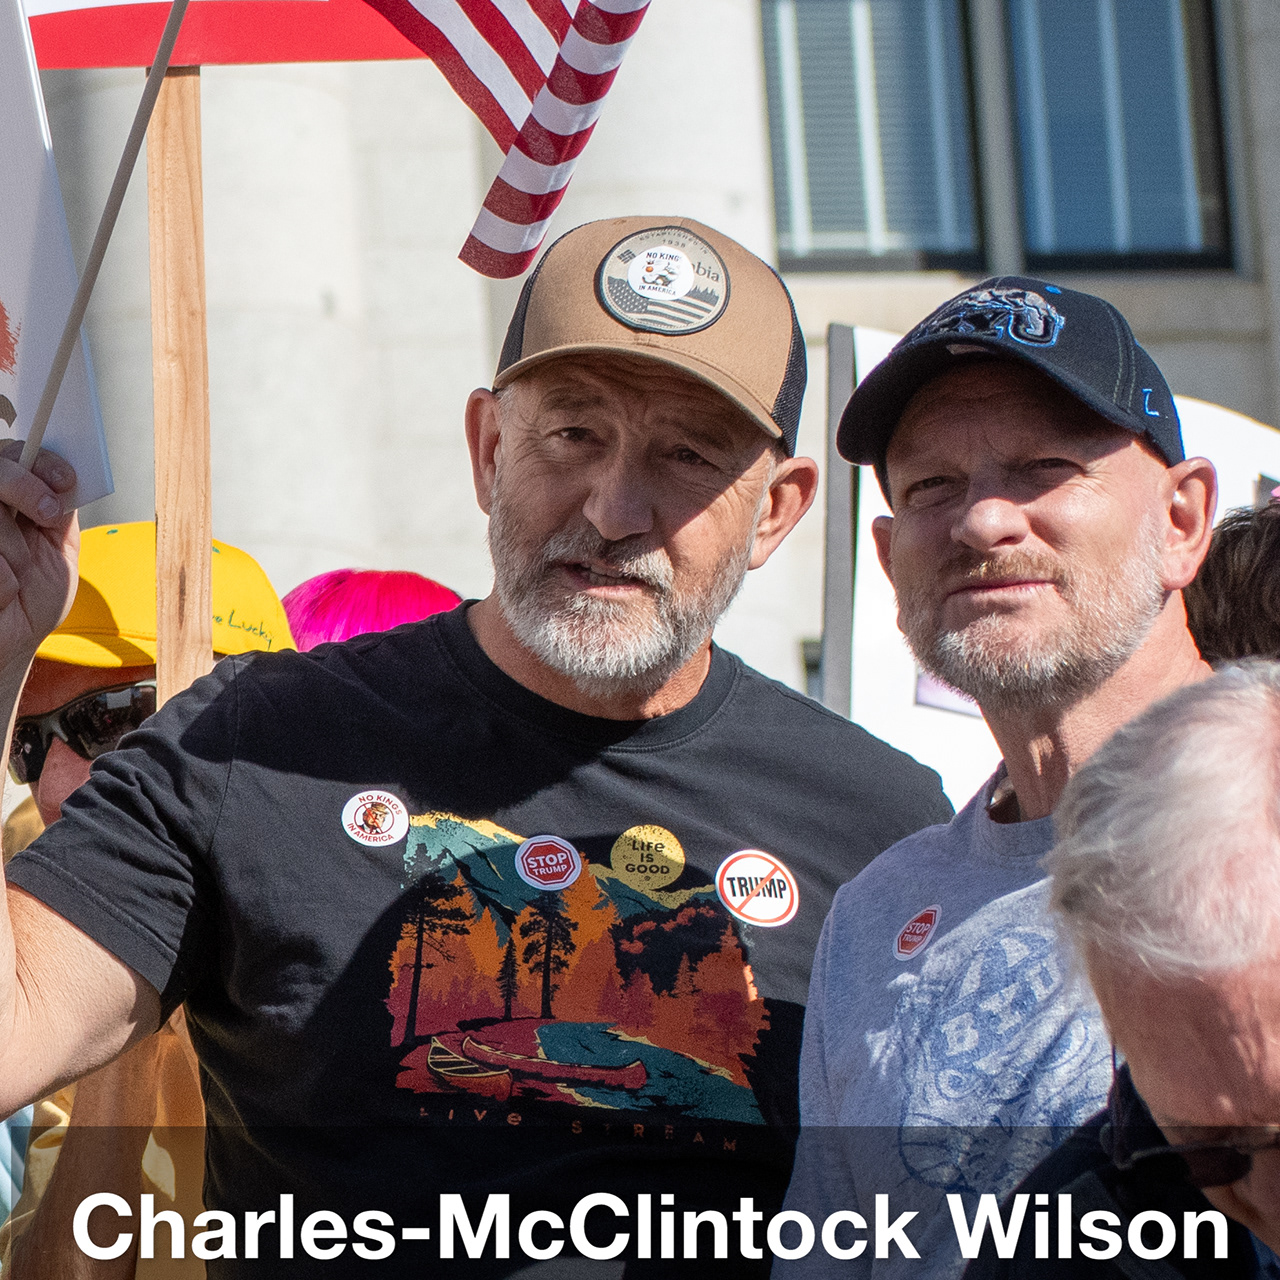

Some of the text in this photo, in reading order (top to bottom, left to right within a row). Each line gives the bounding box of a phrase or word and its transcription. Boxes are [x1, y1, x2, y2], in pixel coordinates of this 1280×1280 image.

[647, 285, 677, 296] AMERICA
[358, 795, 402, 815] NO KINGS
[347, 822, 395, 842] IN AMERICA
[527, 852, 567, 868] STOP
[640, 853, 654, 862] IS
[532, 864, 568, 875] TRUMP
[625, 863, 670, 874] GOOD
[726, 876, 787, 899] TRUMP
[906, 922, 931, 934] STOP
